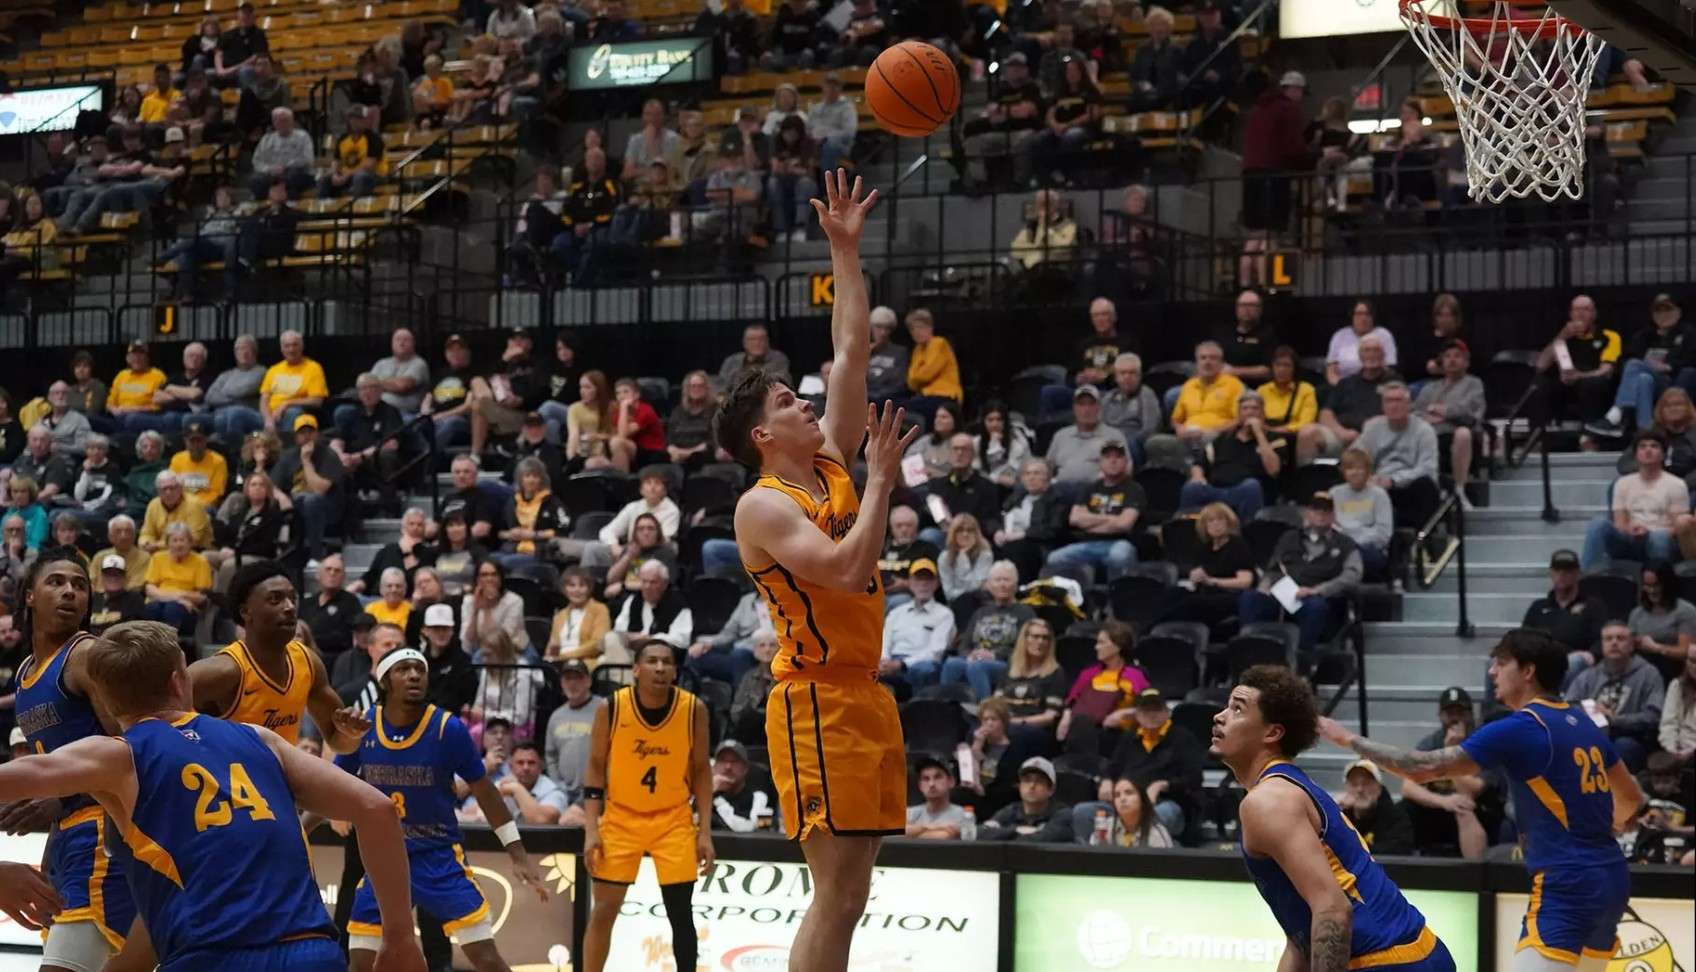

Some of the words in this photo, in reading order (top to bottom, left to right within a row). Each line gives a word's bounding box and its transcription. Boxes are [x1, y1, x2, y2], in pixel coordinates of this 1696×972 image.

[1274, 255, 1290, 285] L
[813, 274, 834, 304] K
[160, 305, 173, 333] J
[263, 708, 298, 730] Tigers
[632, 738, 671, 760] Tigers
[641, 766, 657, 794] 4
[1573, 746, 1610, 794] 23
[181, 762, 277, 832] 24
